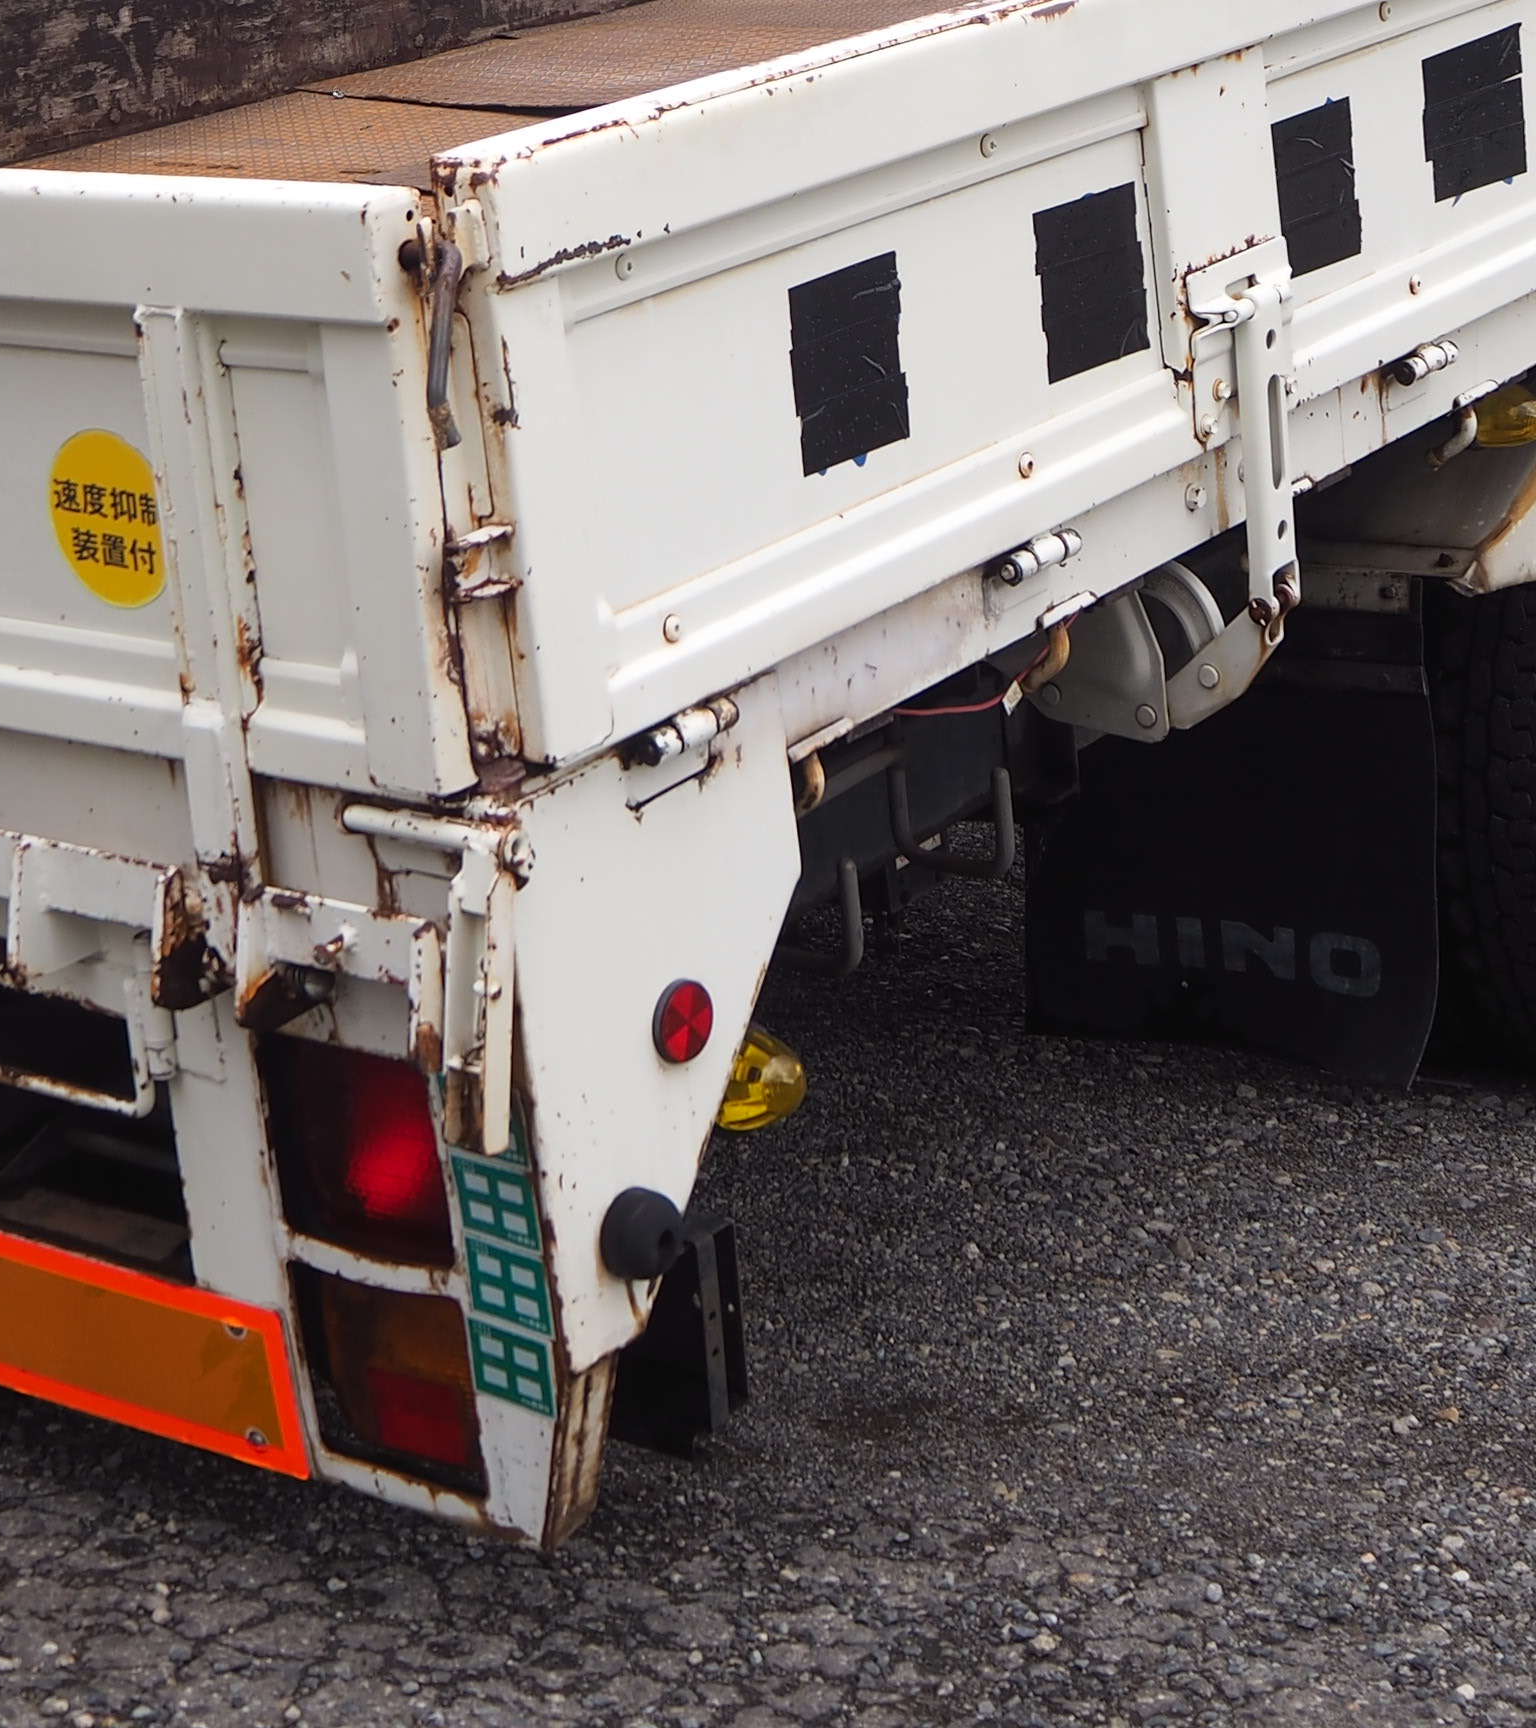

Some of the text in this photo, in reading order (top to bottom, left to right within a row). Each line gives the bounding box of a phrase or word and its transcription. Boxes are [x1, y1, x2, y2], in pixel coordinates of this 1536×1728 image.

[70, 526, 157, 575] 装置付
[1083, 909, 1383, 998] HINO
